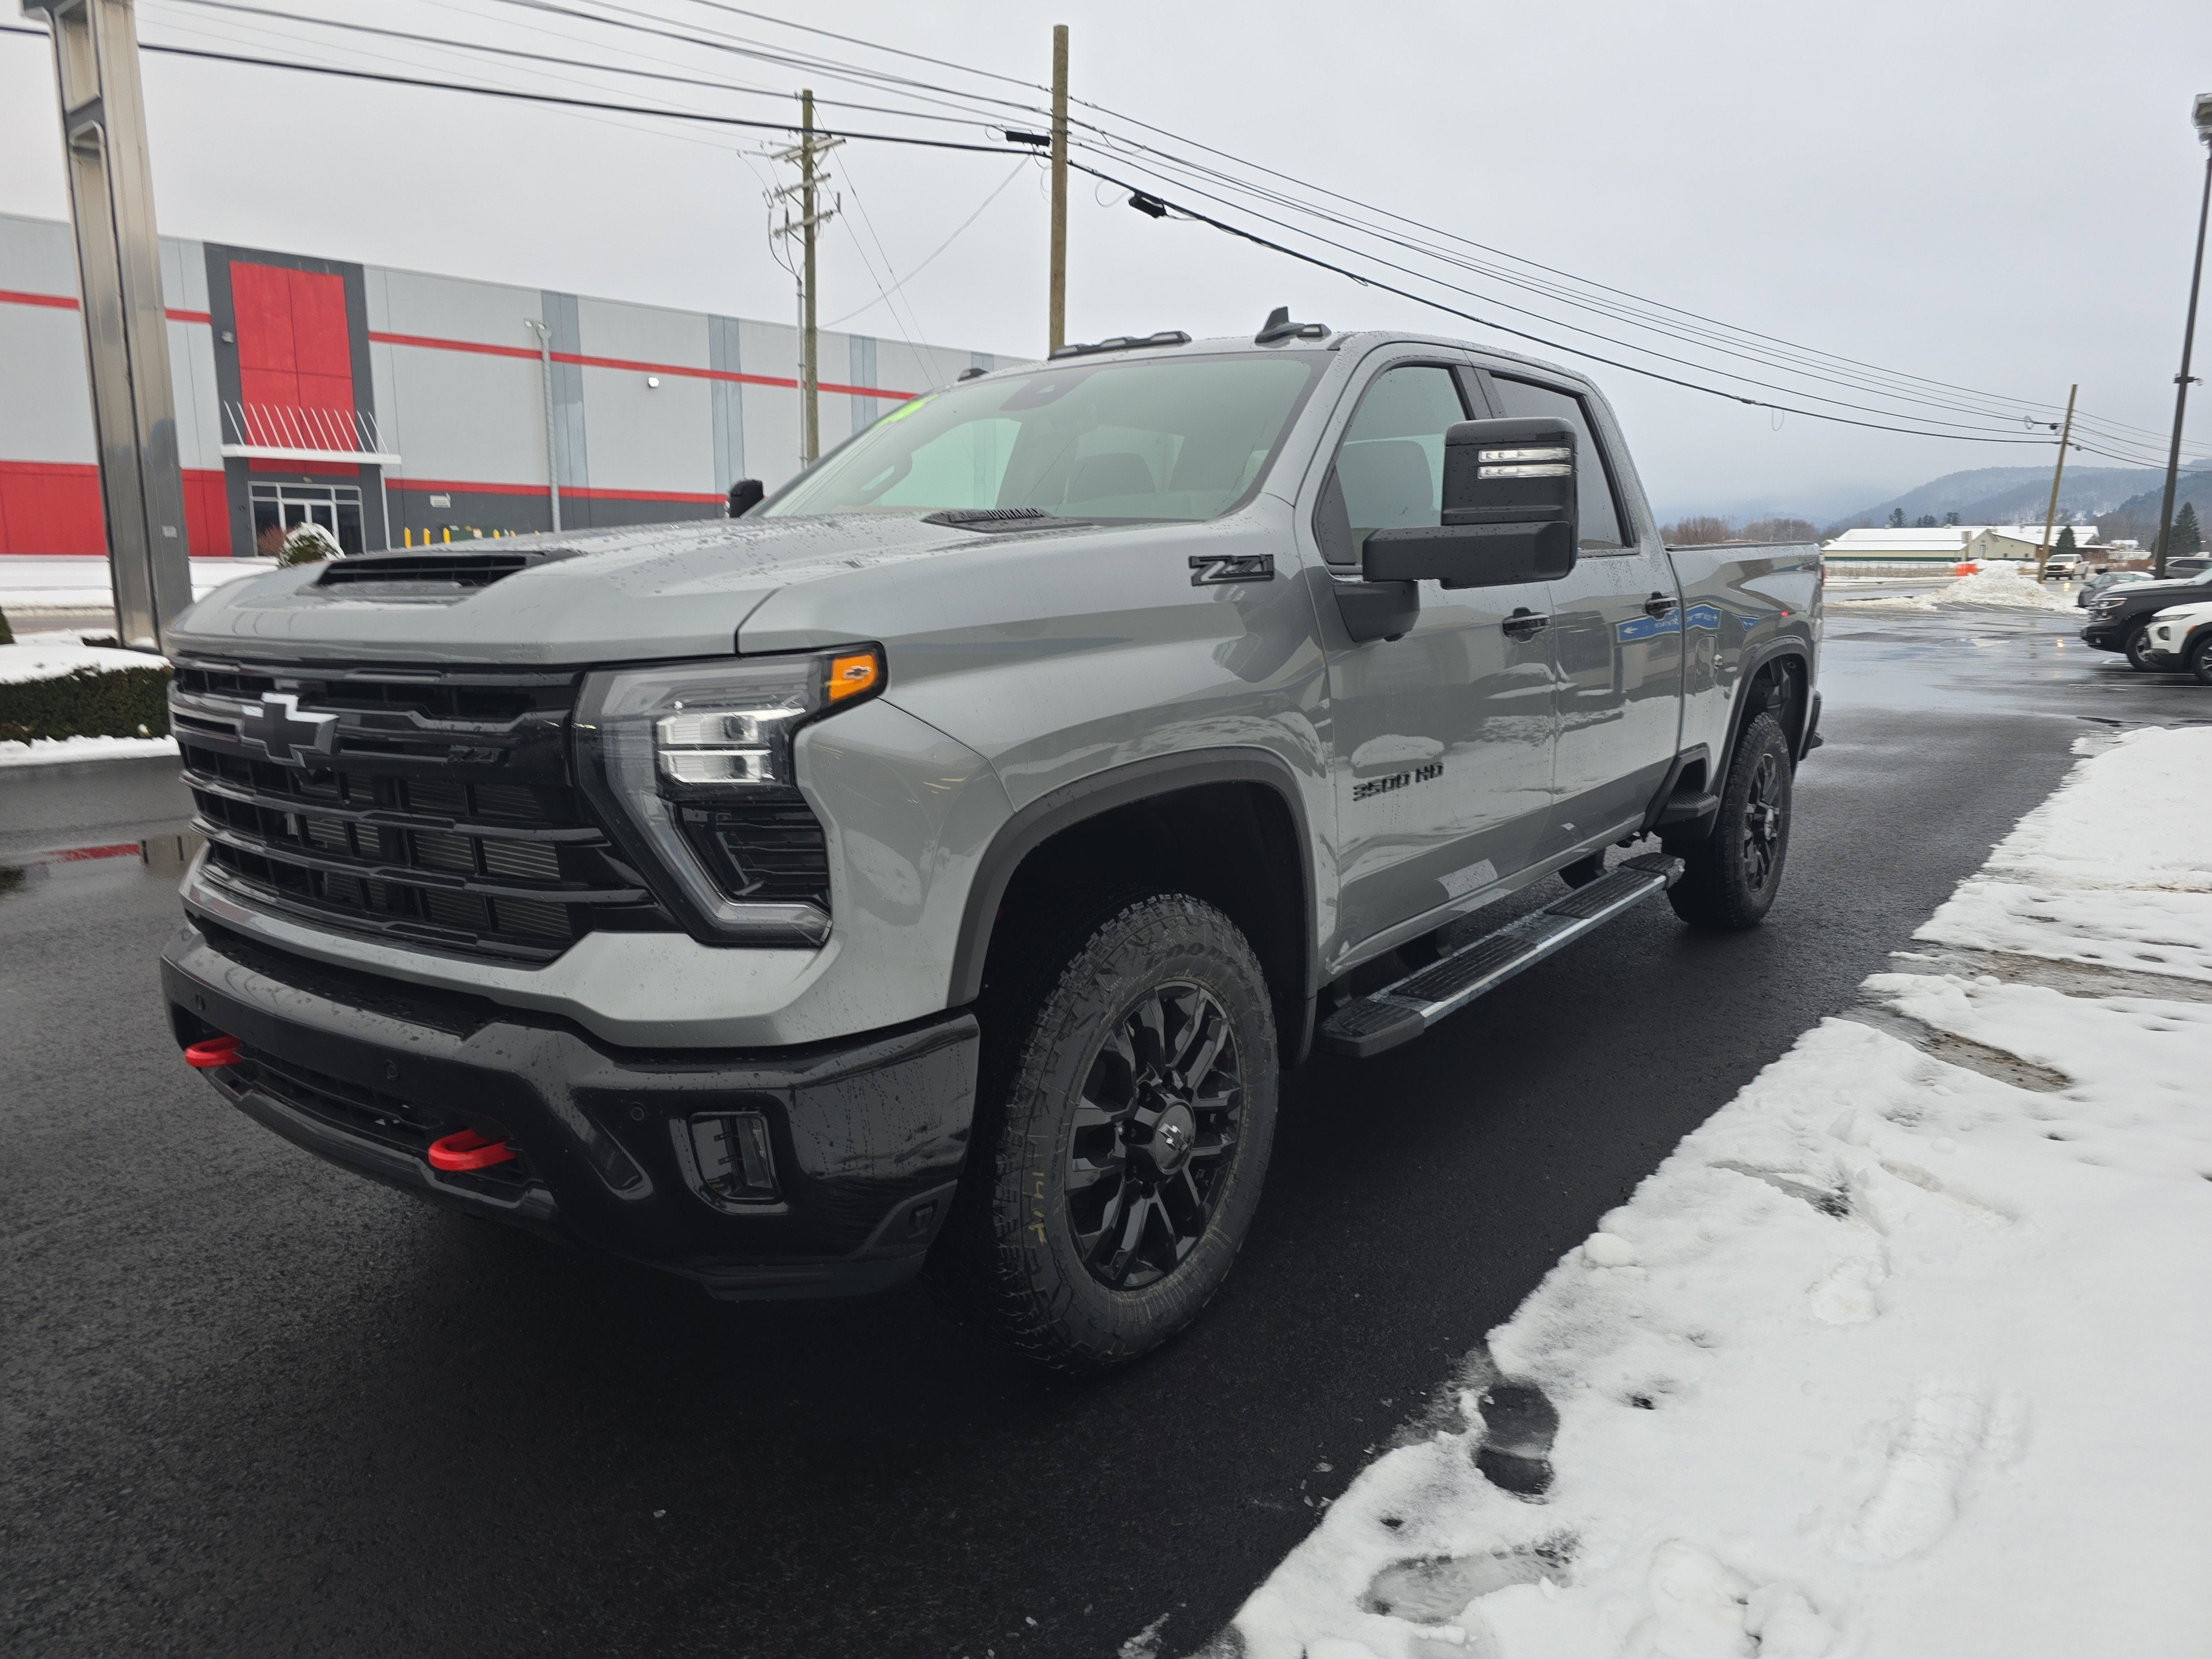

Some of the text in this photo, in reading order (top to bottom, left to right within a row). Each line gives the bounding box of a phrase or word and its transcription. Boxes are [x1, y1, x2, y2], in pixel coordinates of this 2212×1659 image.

[1188, 554, 1274, 587] Z71
[1353, 761, 1444, 802] 3500 HD
